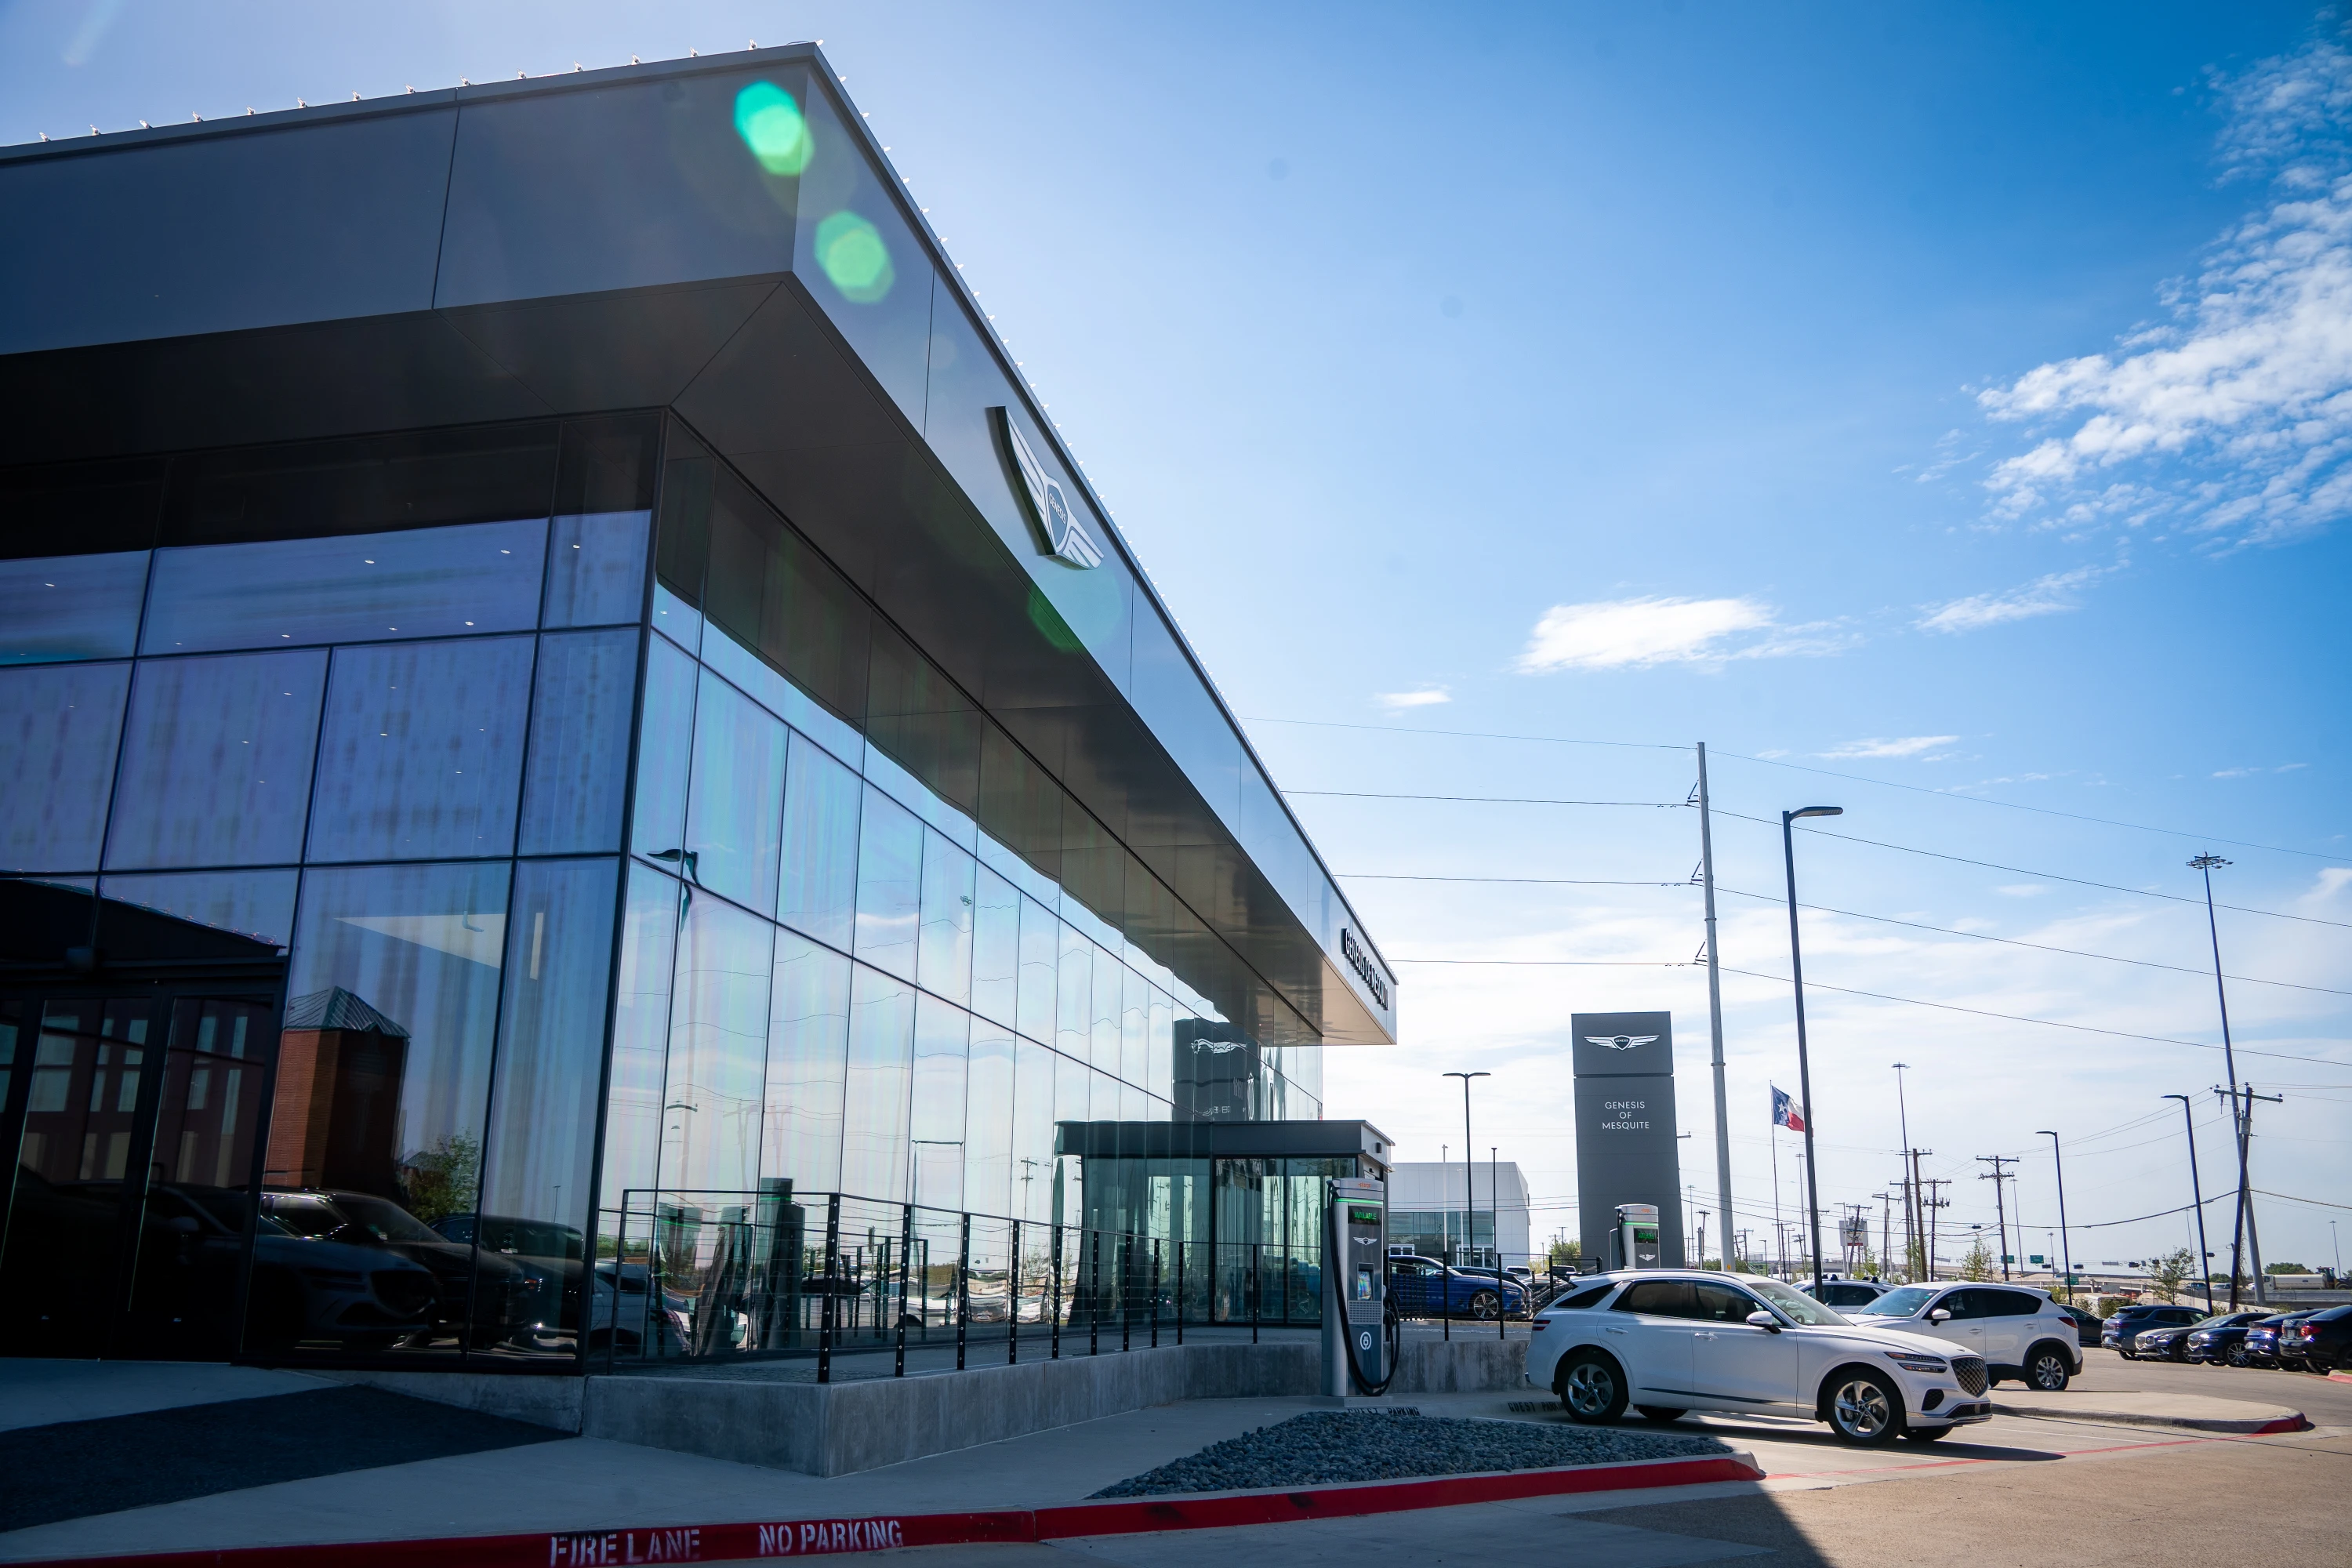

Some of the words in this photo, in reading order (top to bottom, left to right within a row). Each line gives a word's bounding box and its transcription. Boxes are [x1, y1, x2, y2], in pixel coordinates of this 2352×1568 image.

[1048, 493, 1066, 524] GENESIS
[1605, 1101, 1646, 1109] GENESIS
[1619, 1111, 1632, 1120] OF
[1602, 1121, 1650, 1130] MESQUITE
[1354, 1211, 1377, 1220] AVAILABLE
[1386, 1406, 1421, 1417] PARKING
[1508, 1402, 1536, 1412] GUEST
[550, 1534, 618, 1567] FIRE
[626, 1529, 700, 1563] LANE
[759, 1525, 793, 1555] NO
[800, 1520, 903, 1553] PARKING
